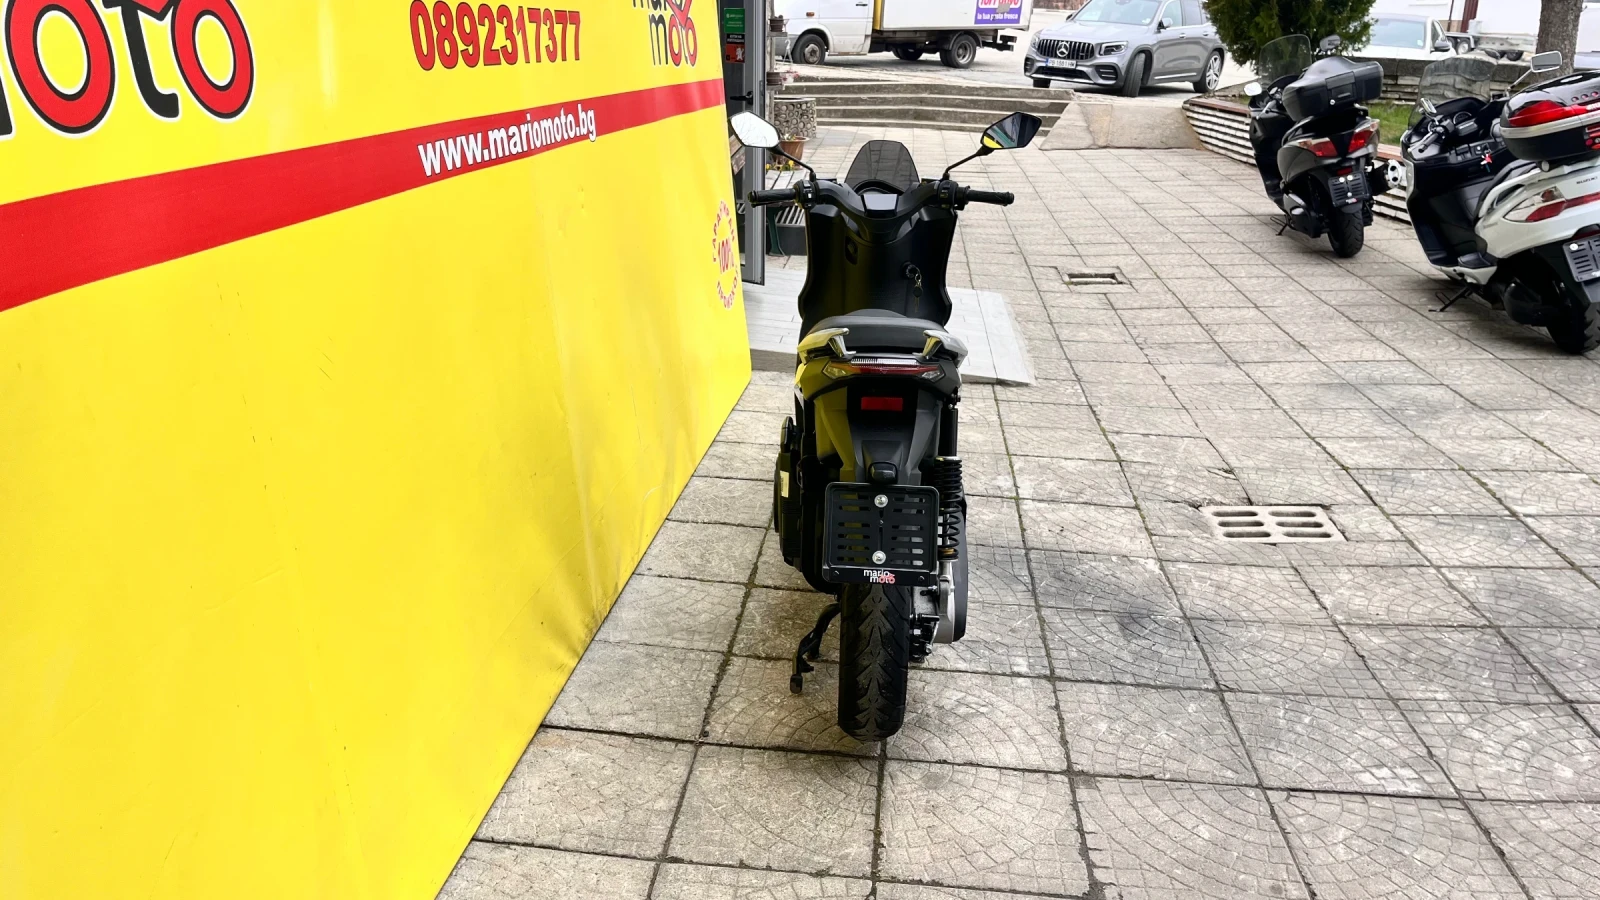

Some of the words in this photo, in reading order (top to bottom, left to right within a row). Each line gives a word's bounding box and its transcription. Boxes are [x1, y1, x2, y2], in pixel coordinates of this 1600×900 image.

[410, 0, 581, 71] 0892317377
[648, 13, 698, 67] moto
[0, 0, 254, 136] oto
[417, 103, 597, 177] www.mariomoto.bg
[863, 568, 891, 577] mario
[869, 575, 896, 584] moto
